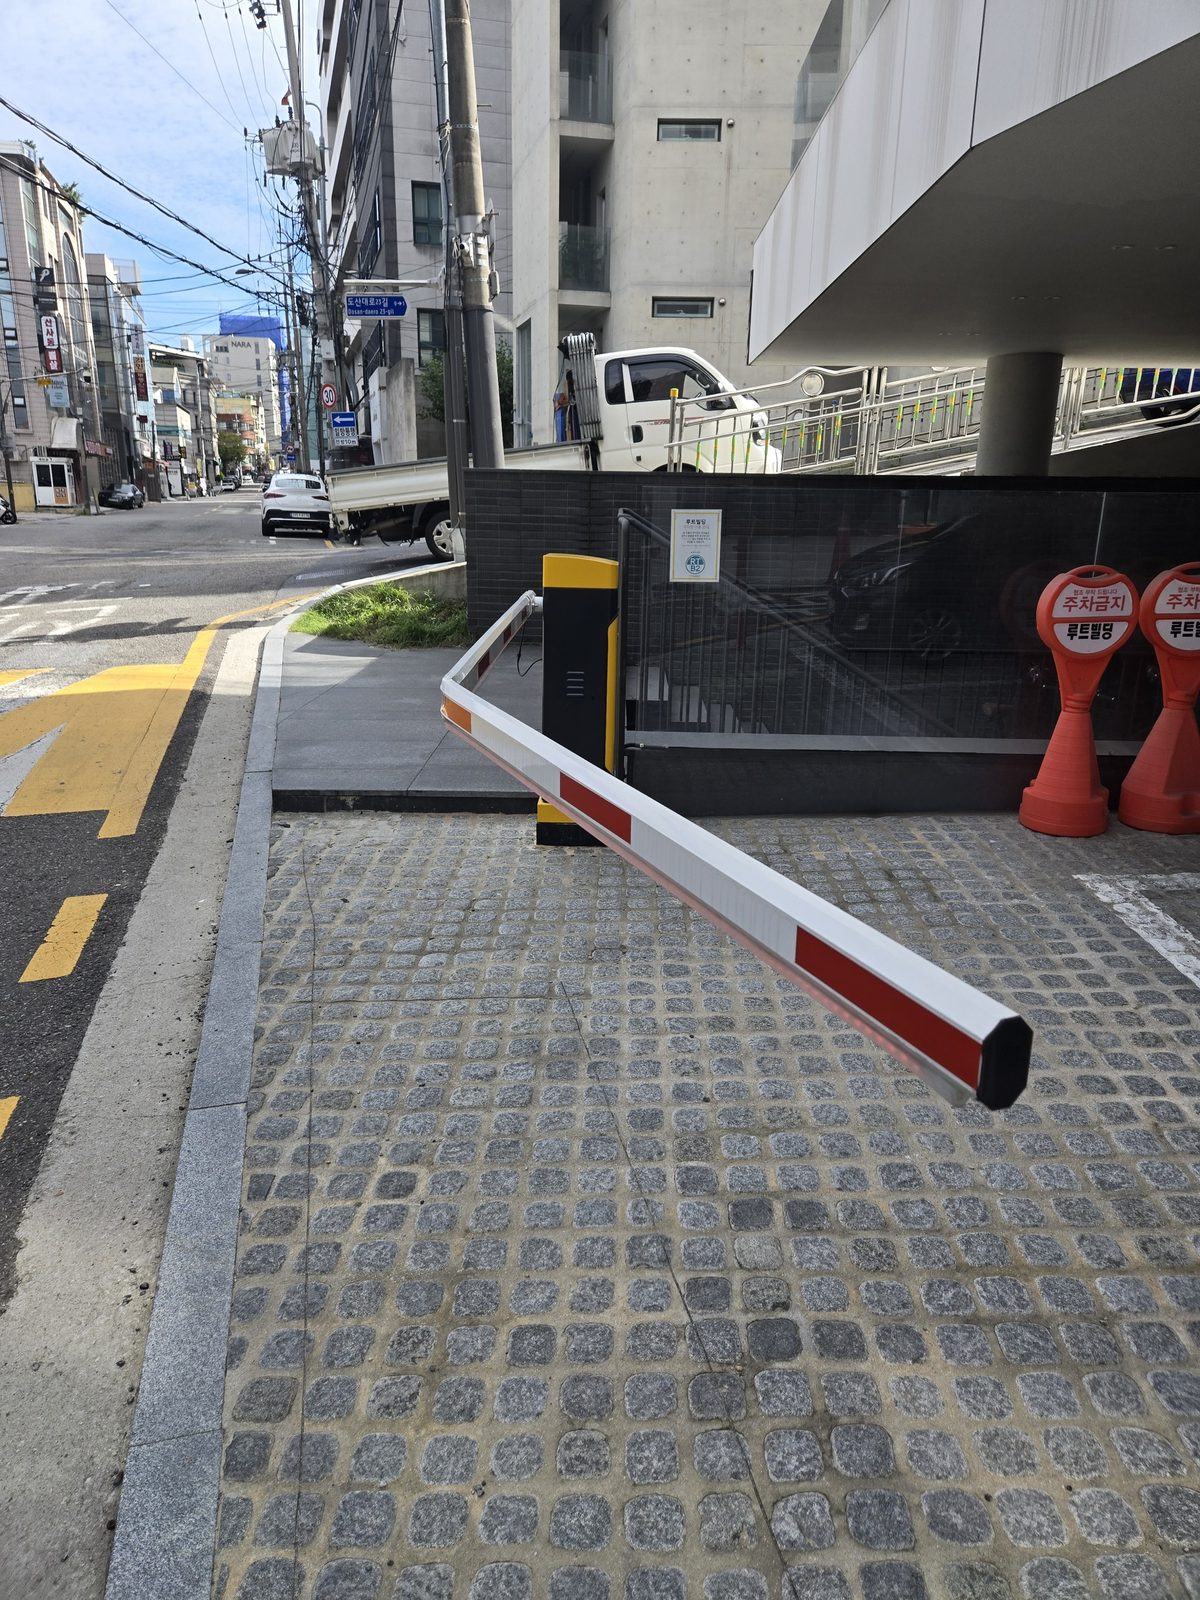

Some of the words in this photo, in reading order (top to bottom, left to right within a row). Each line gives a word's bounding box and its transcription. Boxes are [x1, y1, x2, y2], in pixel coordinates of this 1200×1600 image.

[324, 389, 333, 403] 30
[1063, 595, 1125, 612] 주차금지
[1067, 623, 1113, 640] 루트빌딩
